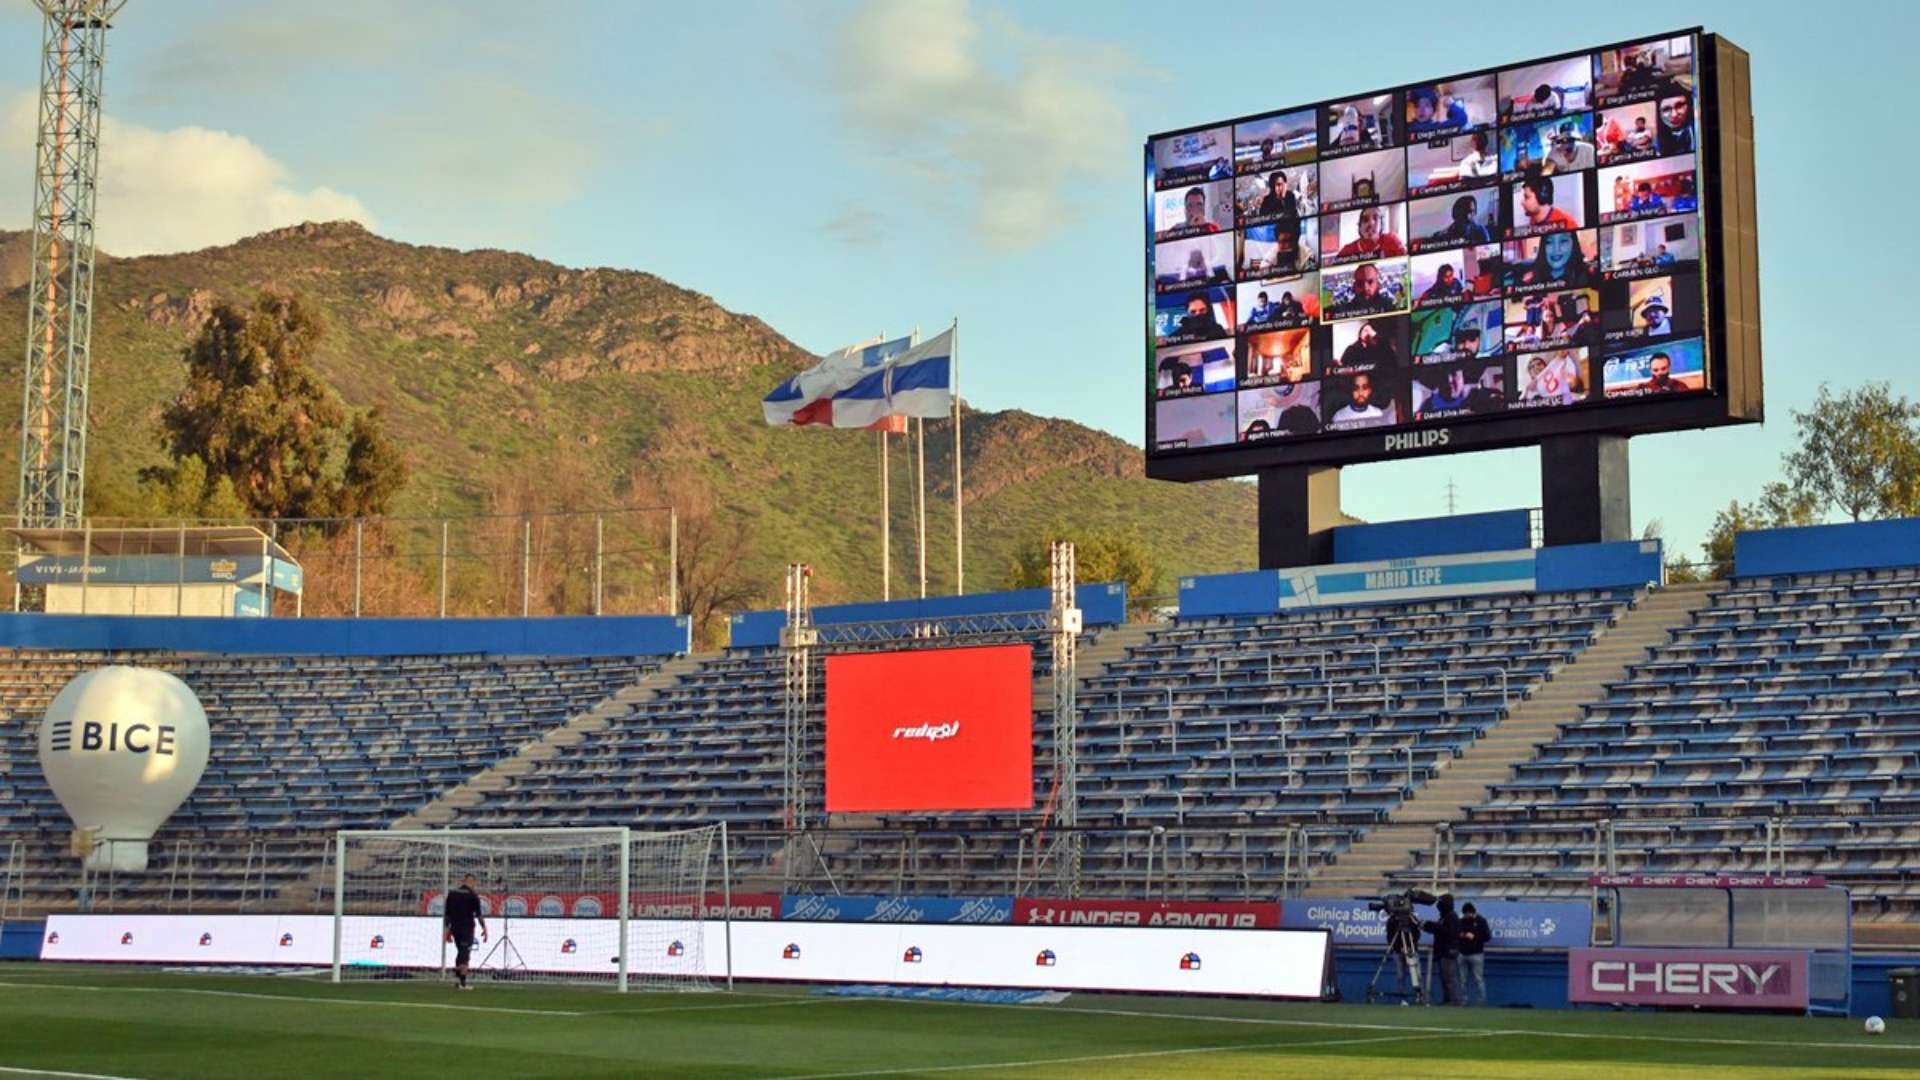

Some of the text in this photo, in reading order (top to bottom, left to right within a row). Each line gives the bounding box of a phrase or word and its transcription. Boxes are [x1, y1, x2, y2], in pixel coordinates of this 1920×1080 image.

[1385, 428, 1448, 451] PHILIPS
[1365, 567, 1441, 590] MARIO LEPE
[82, 721, 175, 755] BICE
[1601, 877, 1634, 886] CHERY
[1643, 877, 1677, 886] CHERY
[1685, 877, 1720, 886] CHERY
[1729, 877, 1765, 886] CHERY
[1773, 877, 1810, 886] CHERY
[637, 904, 693, 918] UNDER
[699, 905, 772, 919] ARMOUR
[1059, 910, 1257, 928] UNDER ARMOUR
[1307, 906, 1349, 920] Clínica
[1353, 908, 1376, 921] San
[1591, 961, 1781, 994] CHERY
